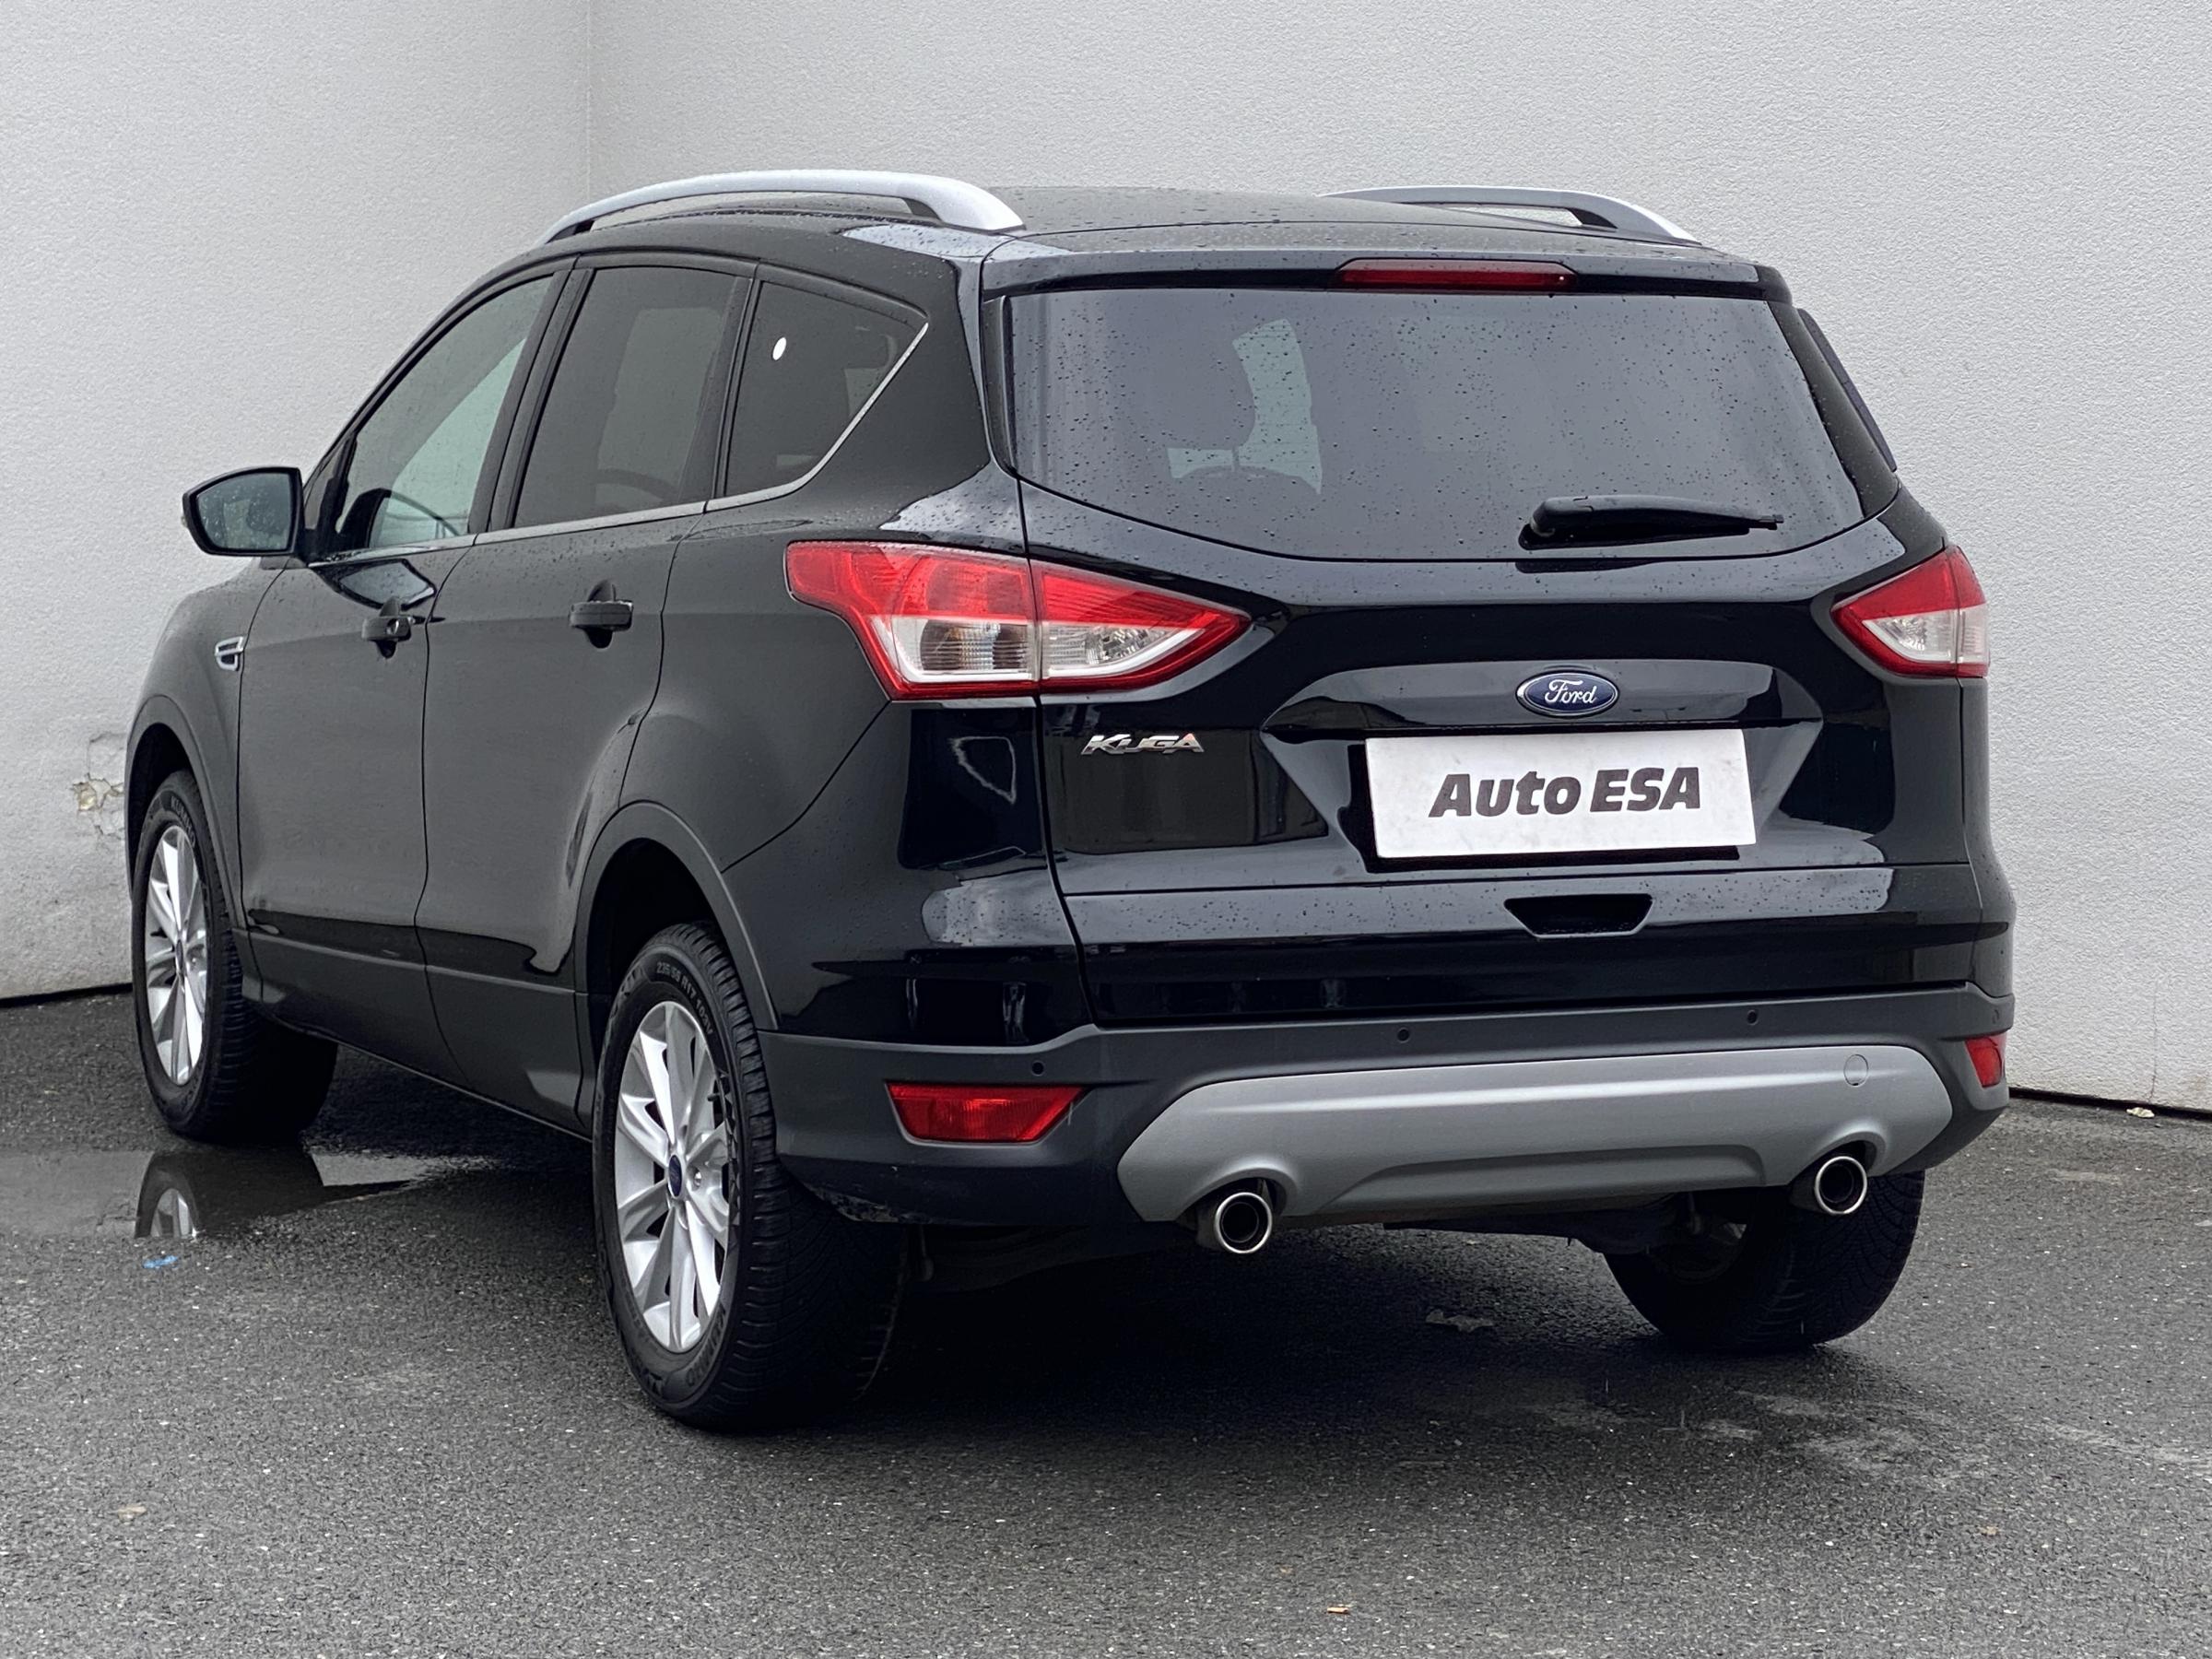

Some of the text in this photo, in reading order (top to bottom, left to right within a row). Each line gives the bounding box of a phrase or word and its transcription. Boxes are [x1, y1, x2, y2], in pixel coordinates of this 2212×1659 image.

[1545, 679, 1597, 704] Ford
[1081, 733, 1204, 755] KUGA
[1429, 767, 1700, 818] Auto ESA
